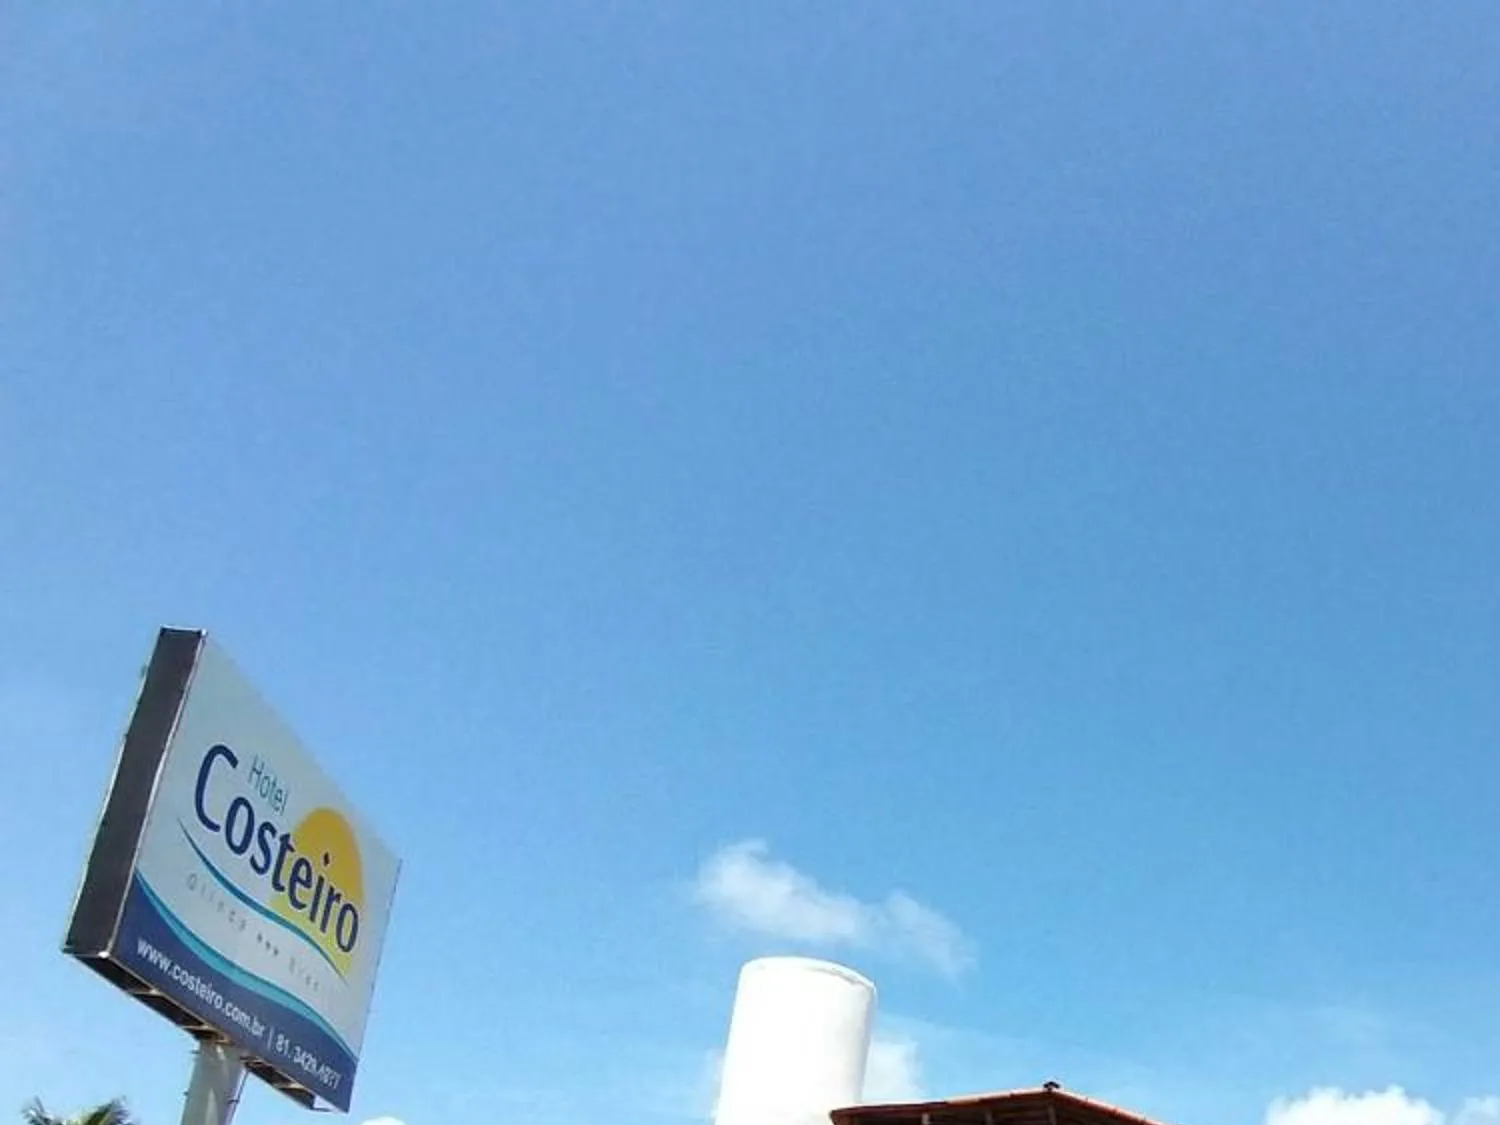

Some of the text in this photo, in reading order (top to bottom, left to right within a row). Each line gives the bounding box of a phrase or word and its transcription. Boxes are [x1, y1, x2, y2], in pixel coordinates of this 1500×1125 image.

[249, 754, 289, 815] Hotel
[195, 744, 358, 953] Costeiro
[136, 938, 265, 1037] www.costeiro.com.br
